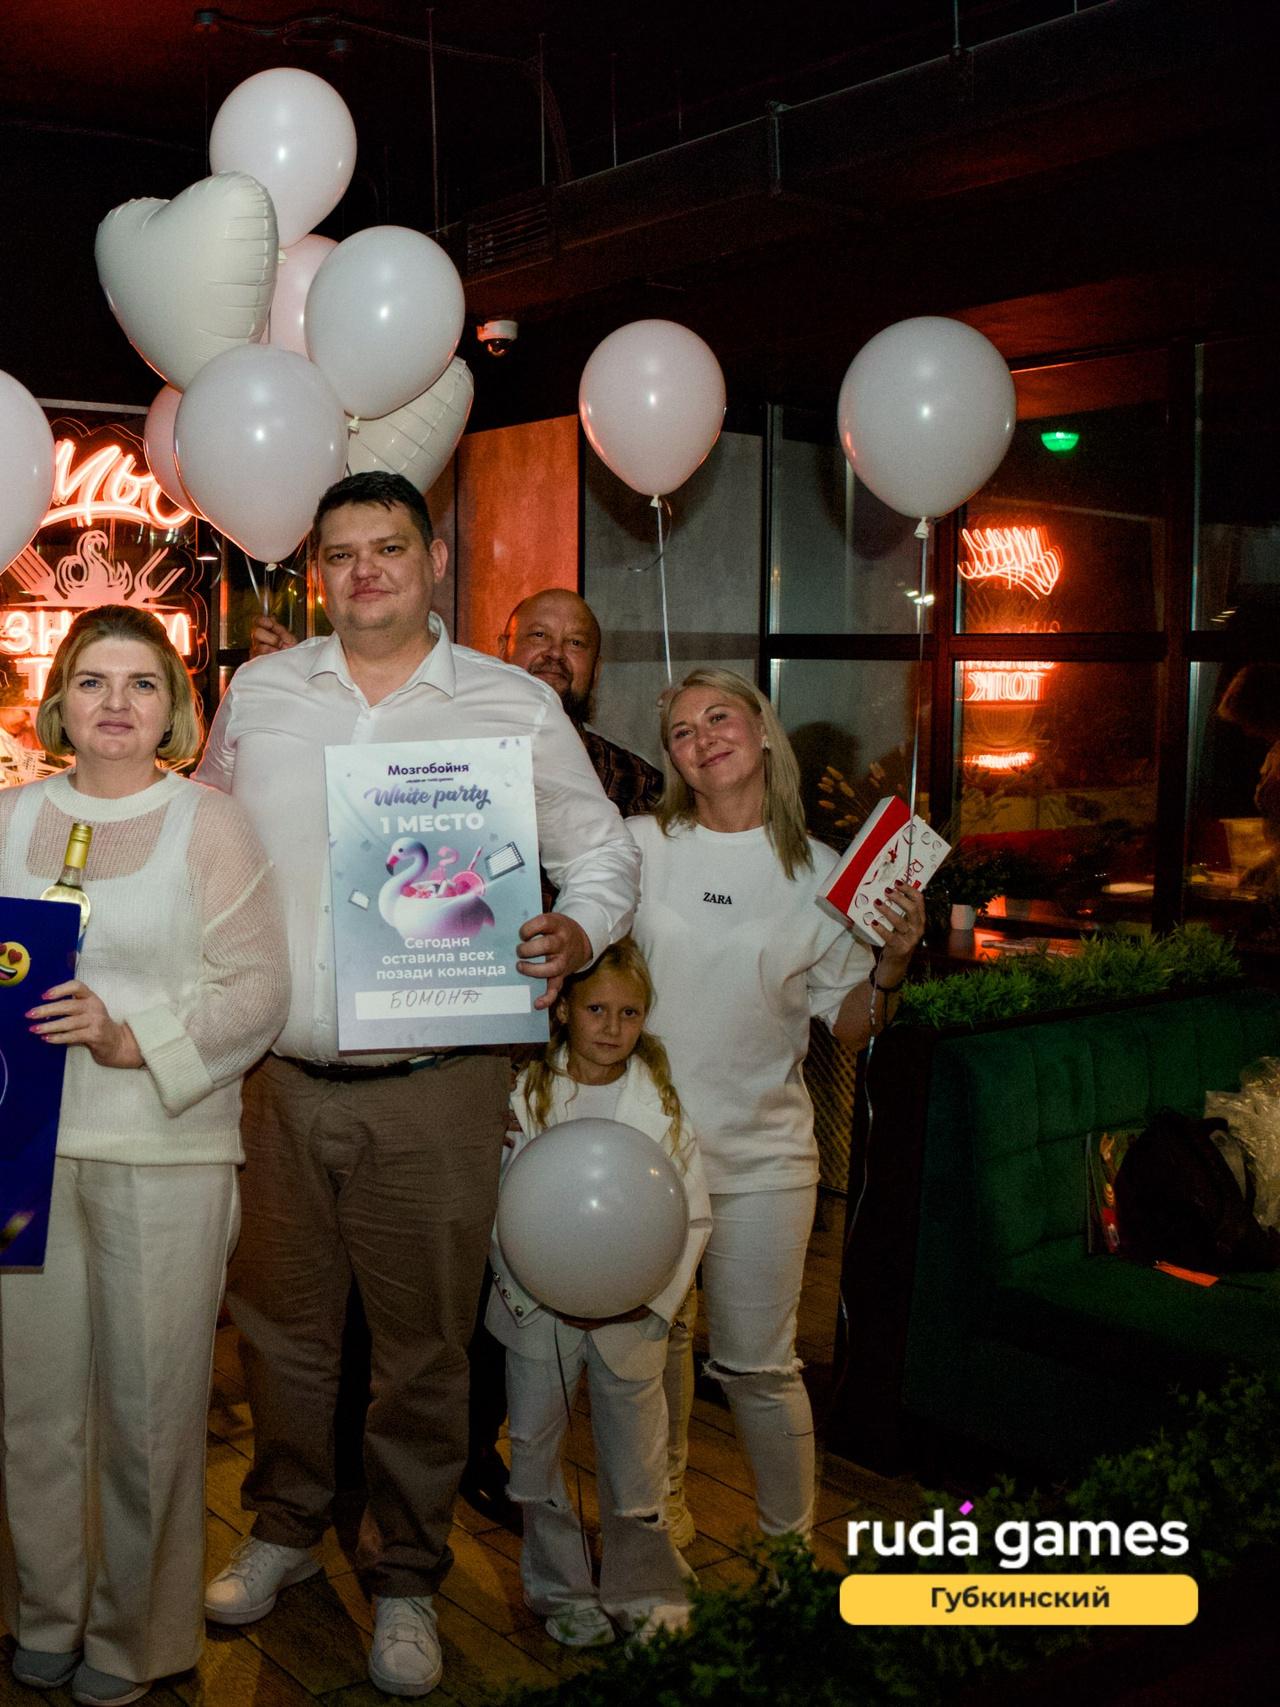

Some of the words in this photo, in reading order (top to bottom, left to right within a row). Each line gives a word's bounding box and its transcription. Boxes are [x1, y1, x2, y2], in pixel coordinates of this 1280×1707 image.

[387, 762, 470, 776] Мозгобойня
[363, 784, 432, 808] White
[432, 783, 492, 811] party
[379, 817, 391, 834] 1
[398, 813, 485, 833] МЕСТО
[703, 892, 733, 905] ZARA
[404, 936, 470, 951] Сегодня
[381, 950, 456, 966] оставила
[459, 950, 495, 963] всех
[376, 967, 433, 982] позади
[437, 965, 507, 979] команда
